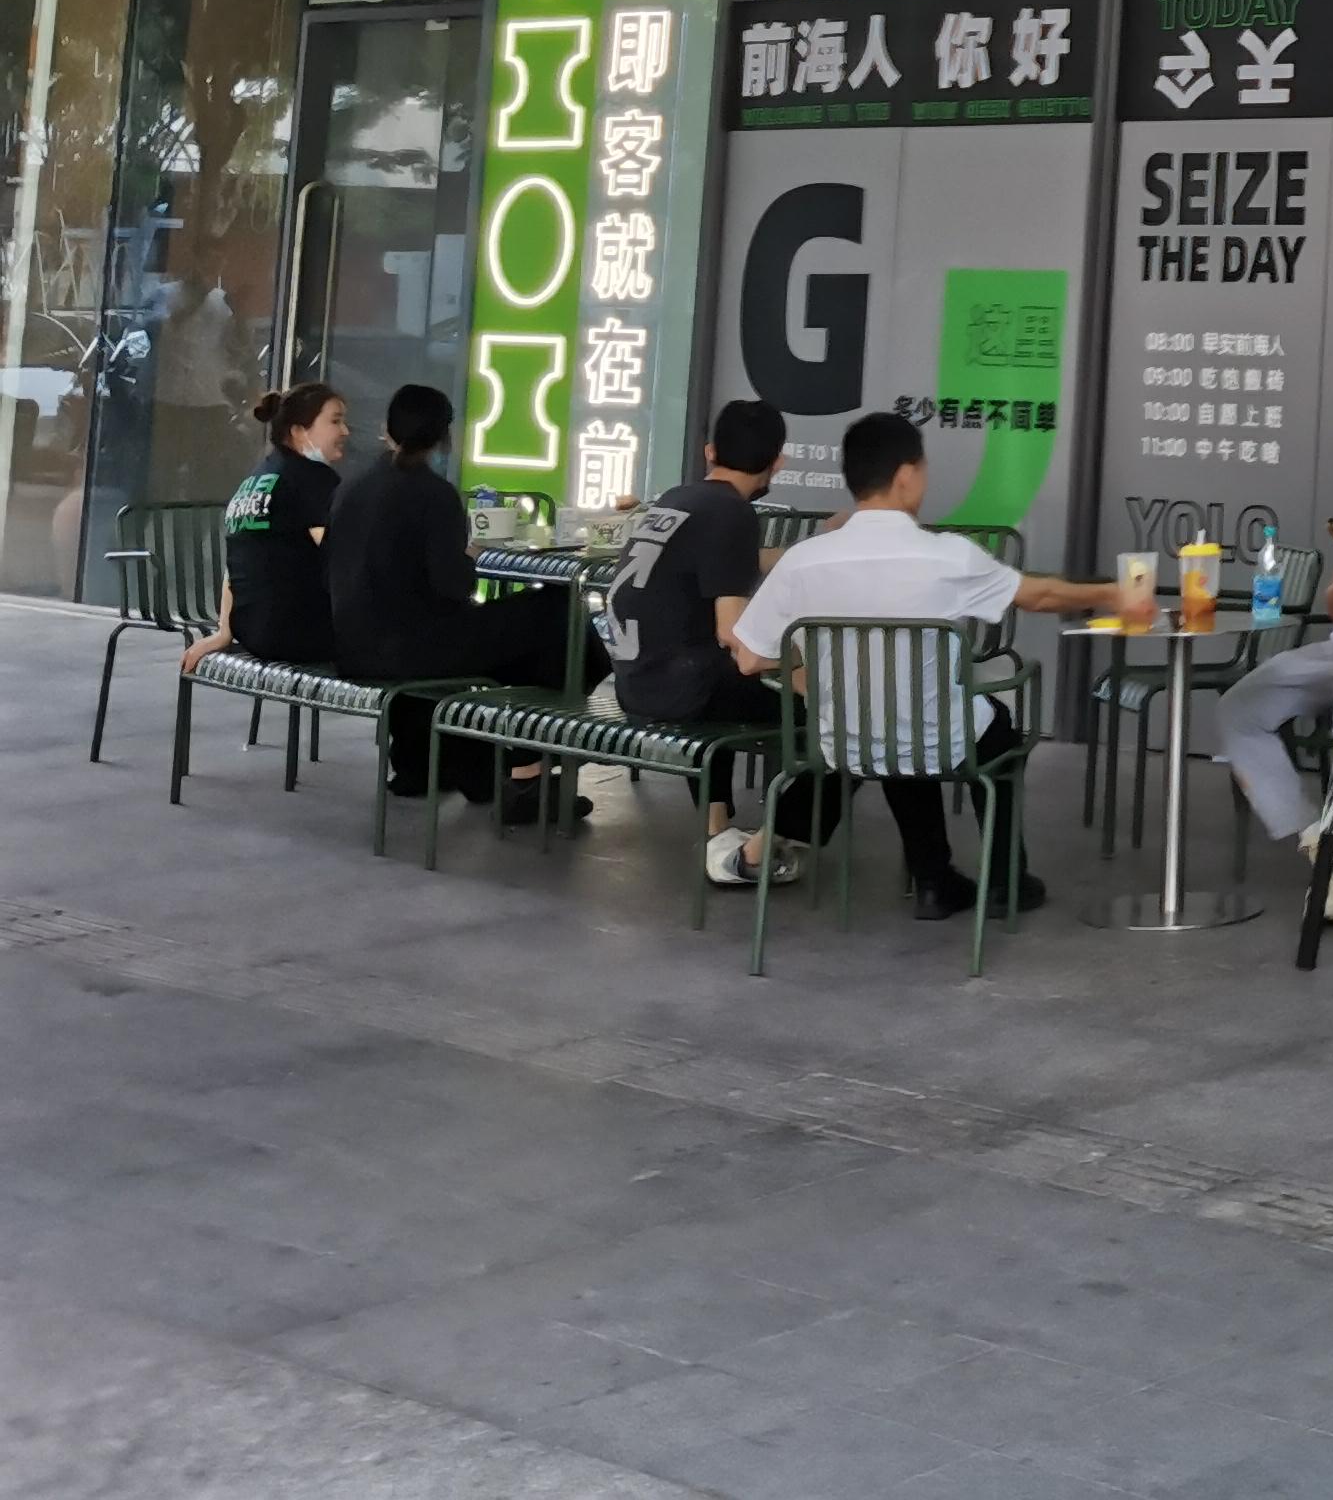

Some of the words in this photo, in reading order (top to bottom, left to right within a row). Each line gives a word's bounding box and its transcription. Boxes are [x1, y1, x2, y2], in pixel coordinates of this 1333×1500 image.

[741, 14, 902, 97] 前海人
[934, 8, 1072, 89] 你好
[1140, 149, 1310, 228] SEIZE
[576, 9, 674, 511] 即客就在前
[740, 182, 870, 416] G
[1138, 235, 1210, 284] THE
[1221, 235, 1307, 285] DAY
